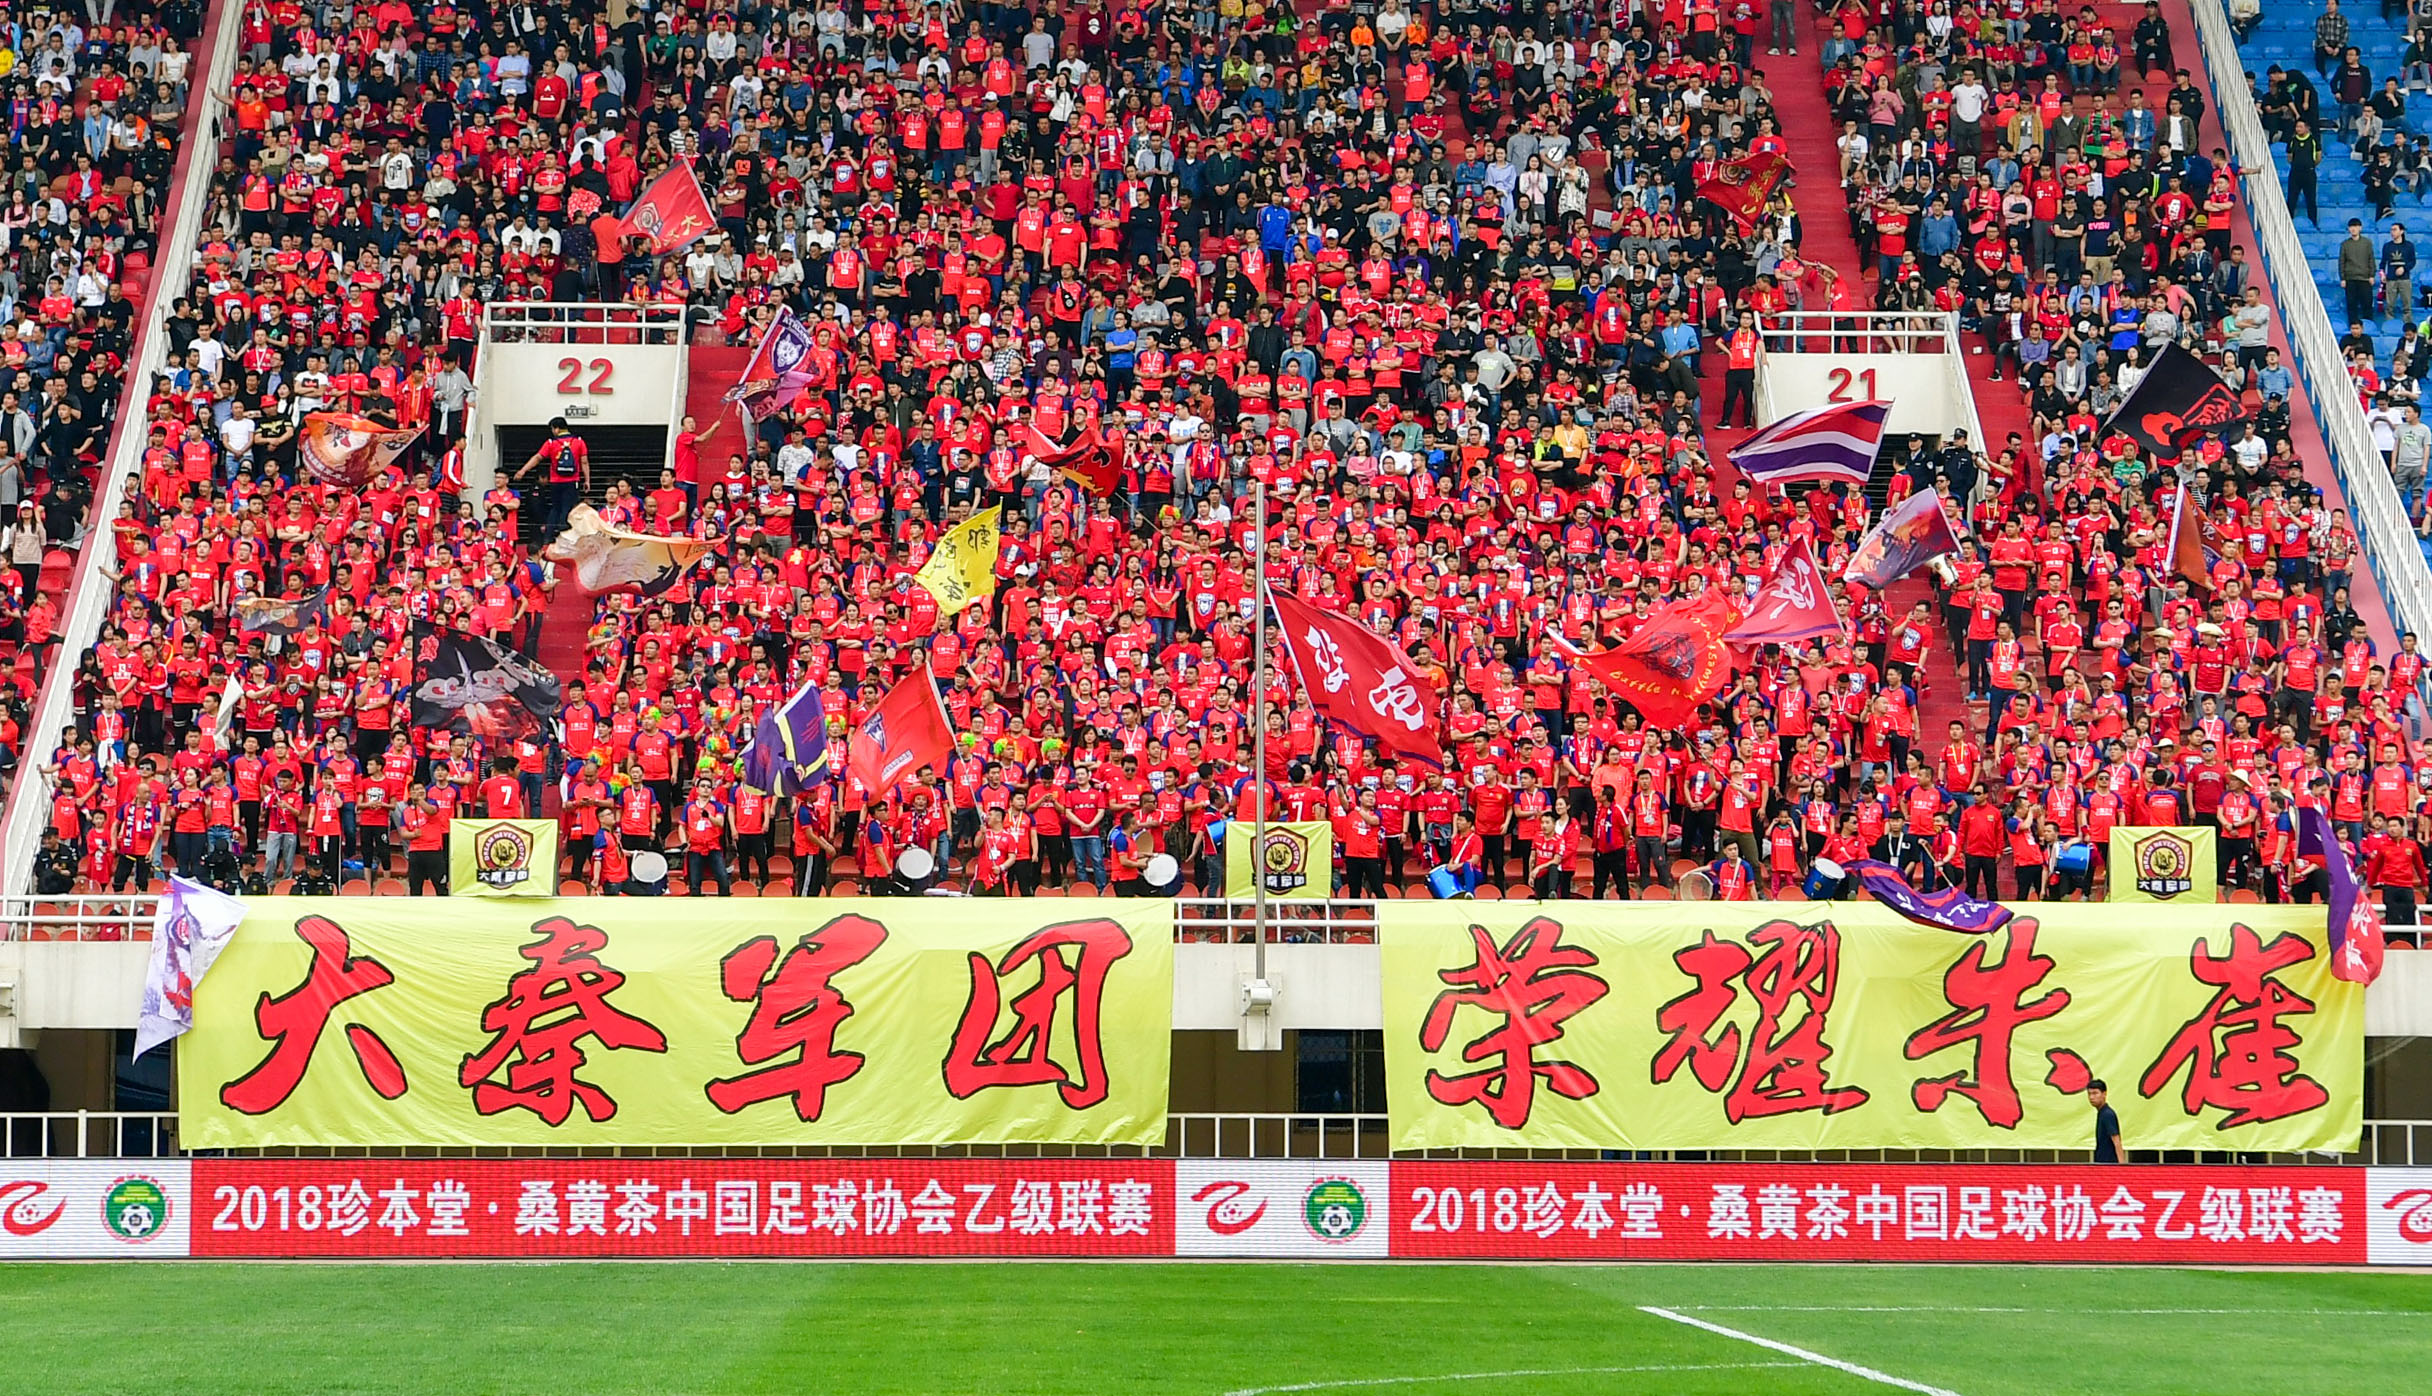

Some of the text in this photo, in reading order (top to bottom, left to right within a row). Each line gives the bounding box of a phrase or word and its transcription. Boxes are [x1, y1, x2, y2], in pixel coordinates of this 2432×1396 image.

[2088, 221, 2111, 230] EVISU
[558, 358, 613, 394] 22
[1829, 368, 1876, 404] 21
[1609, 670, 1661, 694] Battle
[501, 786, 513, 806] 7
[1292, 800, 1304, 822] 7
[219, 913, 1131, 1127] 大秦军团
